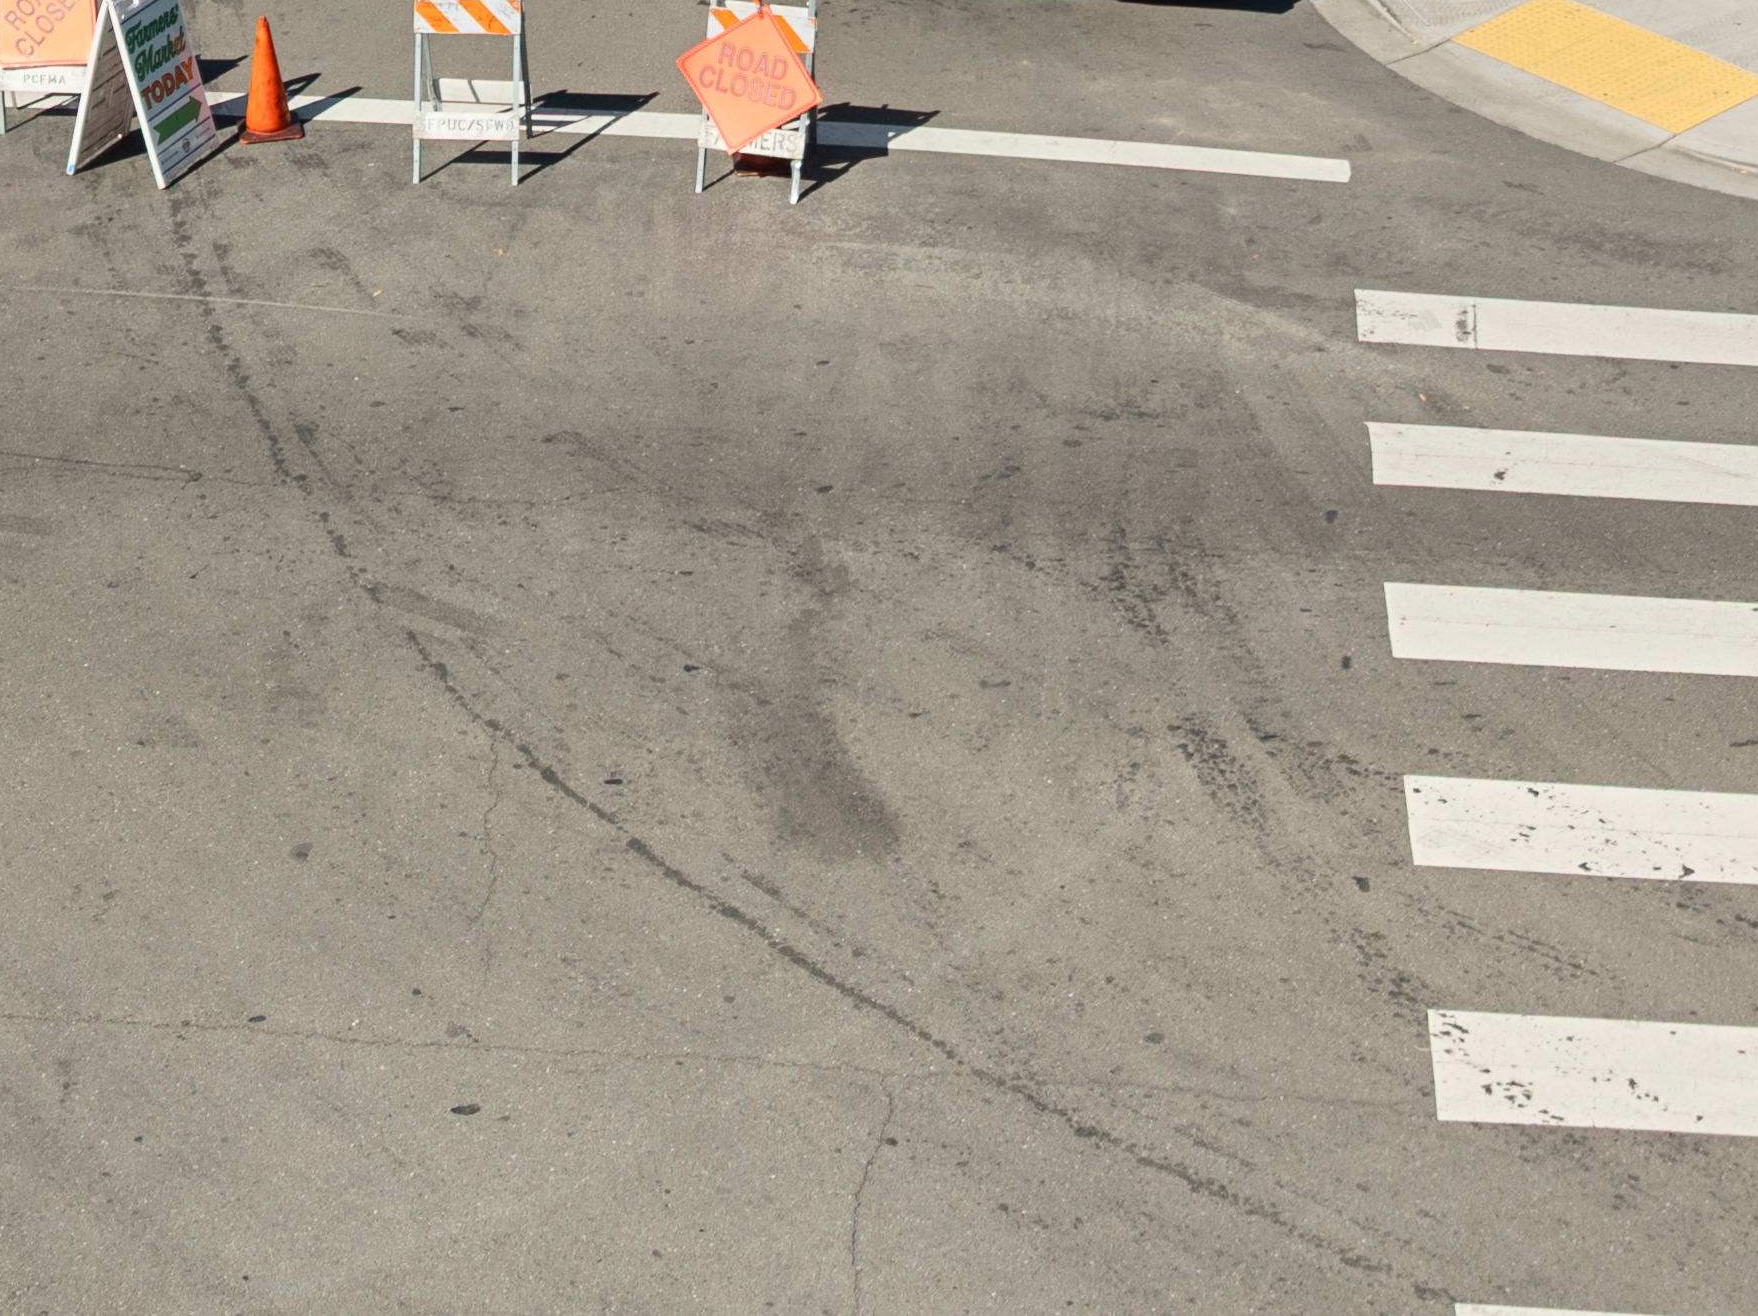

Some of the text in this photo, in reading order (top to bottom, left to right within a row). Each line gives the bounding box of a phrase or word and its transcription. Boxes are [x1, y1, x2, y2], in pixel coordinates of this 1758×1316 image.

[134, 26, 187, 82] Market
[718, 41, 789, 81] ROAD
[23, 73, 67, 84] PCFMA
[141, 56, 196, 110] TODAY
[699, 65, 797, 110] CLOSED
